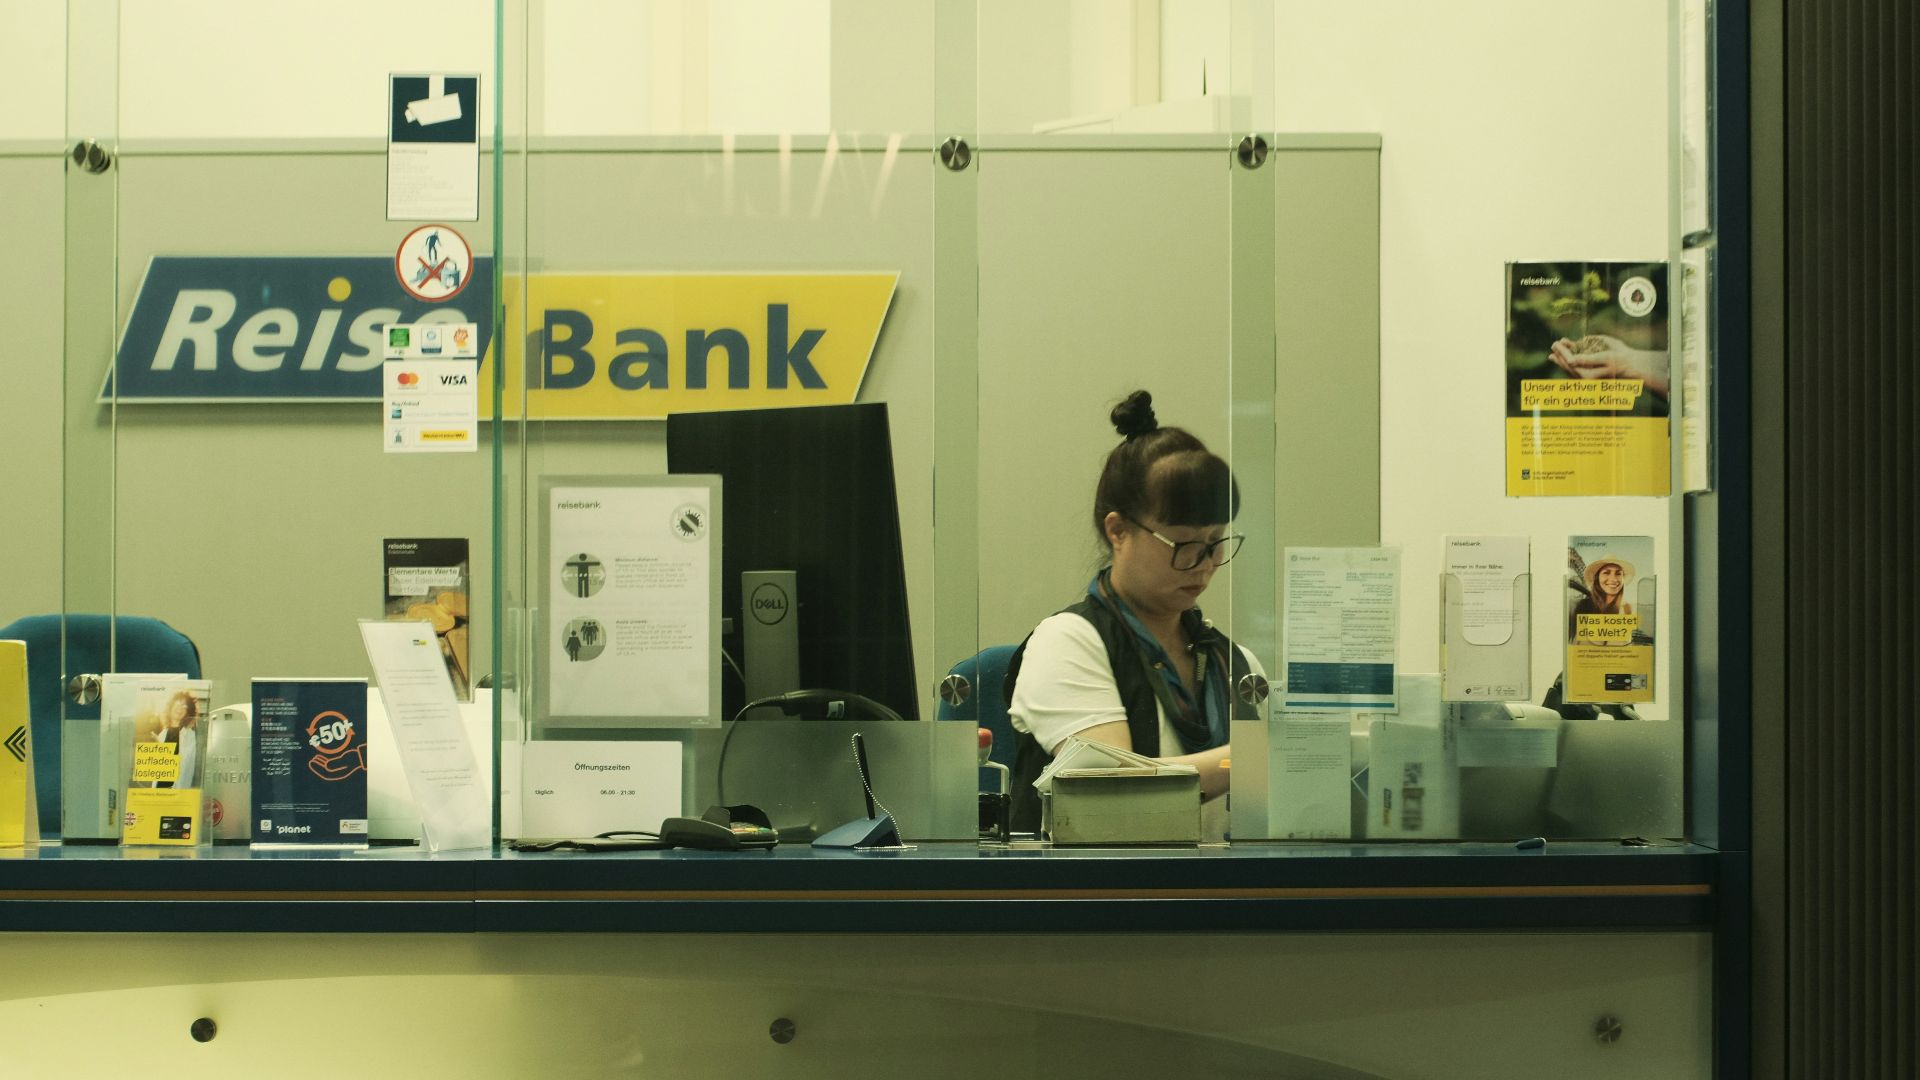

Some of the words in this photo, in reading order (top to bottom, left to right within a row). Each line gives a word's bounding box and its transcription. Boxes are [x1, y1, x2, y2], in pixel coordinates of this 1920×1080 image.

[1520, 277, 1561, 286] reisebank
[150, 277, 469, 373] Reis
[543, 303, 829, 393] Bank
[440, 375, 468, 386] VISA
[1523, 382, 1555, 392] Unser
[1559, 382, 1597, 392] aktiver
[1601, 382, 1640, 394] Beitrag
[1524, 396, 1540, 406] für
[1543, 396, 1560, 405] ein
[1563, 396, 1596, 408] gutes
[1599, 395, 1632, 406] Klima.
[557, 501, 601, 510] reisebank
[389, 567, 433, 576] Elementare
[434, 567, 458, 576] Werte
[755, 599, 784, 609] DELL
[1579, 616, 1601, 625] Was
[1604, 615, 1637, 625] kostet
[1578, 628, 1595, 637] die
[1597, 628, 1628, 637] Welt?
[137, 744, 172, 754] Kaufen,
[136, 757, 178, 767] aufladen,
[574, 762, 631, 773] Öffnungszeiten
[135, 769, 175, 780] loslegen!
[278, 825, 312, 835] planet
